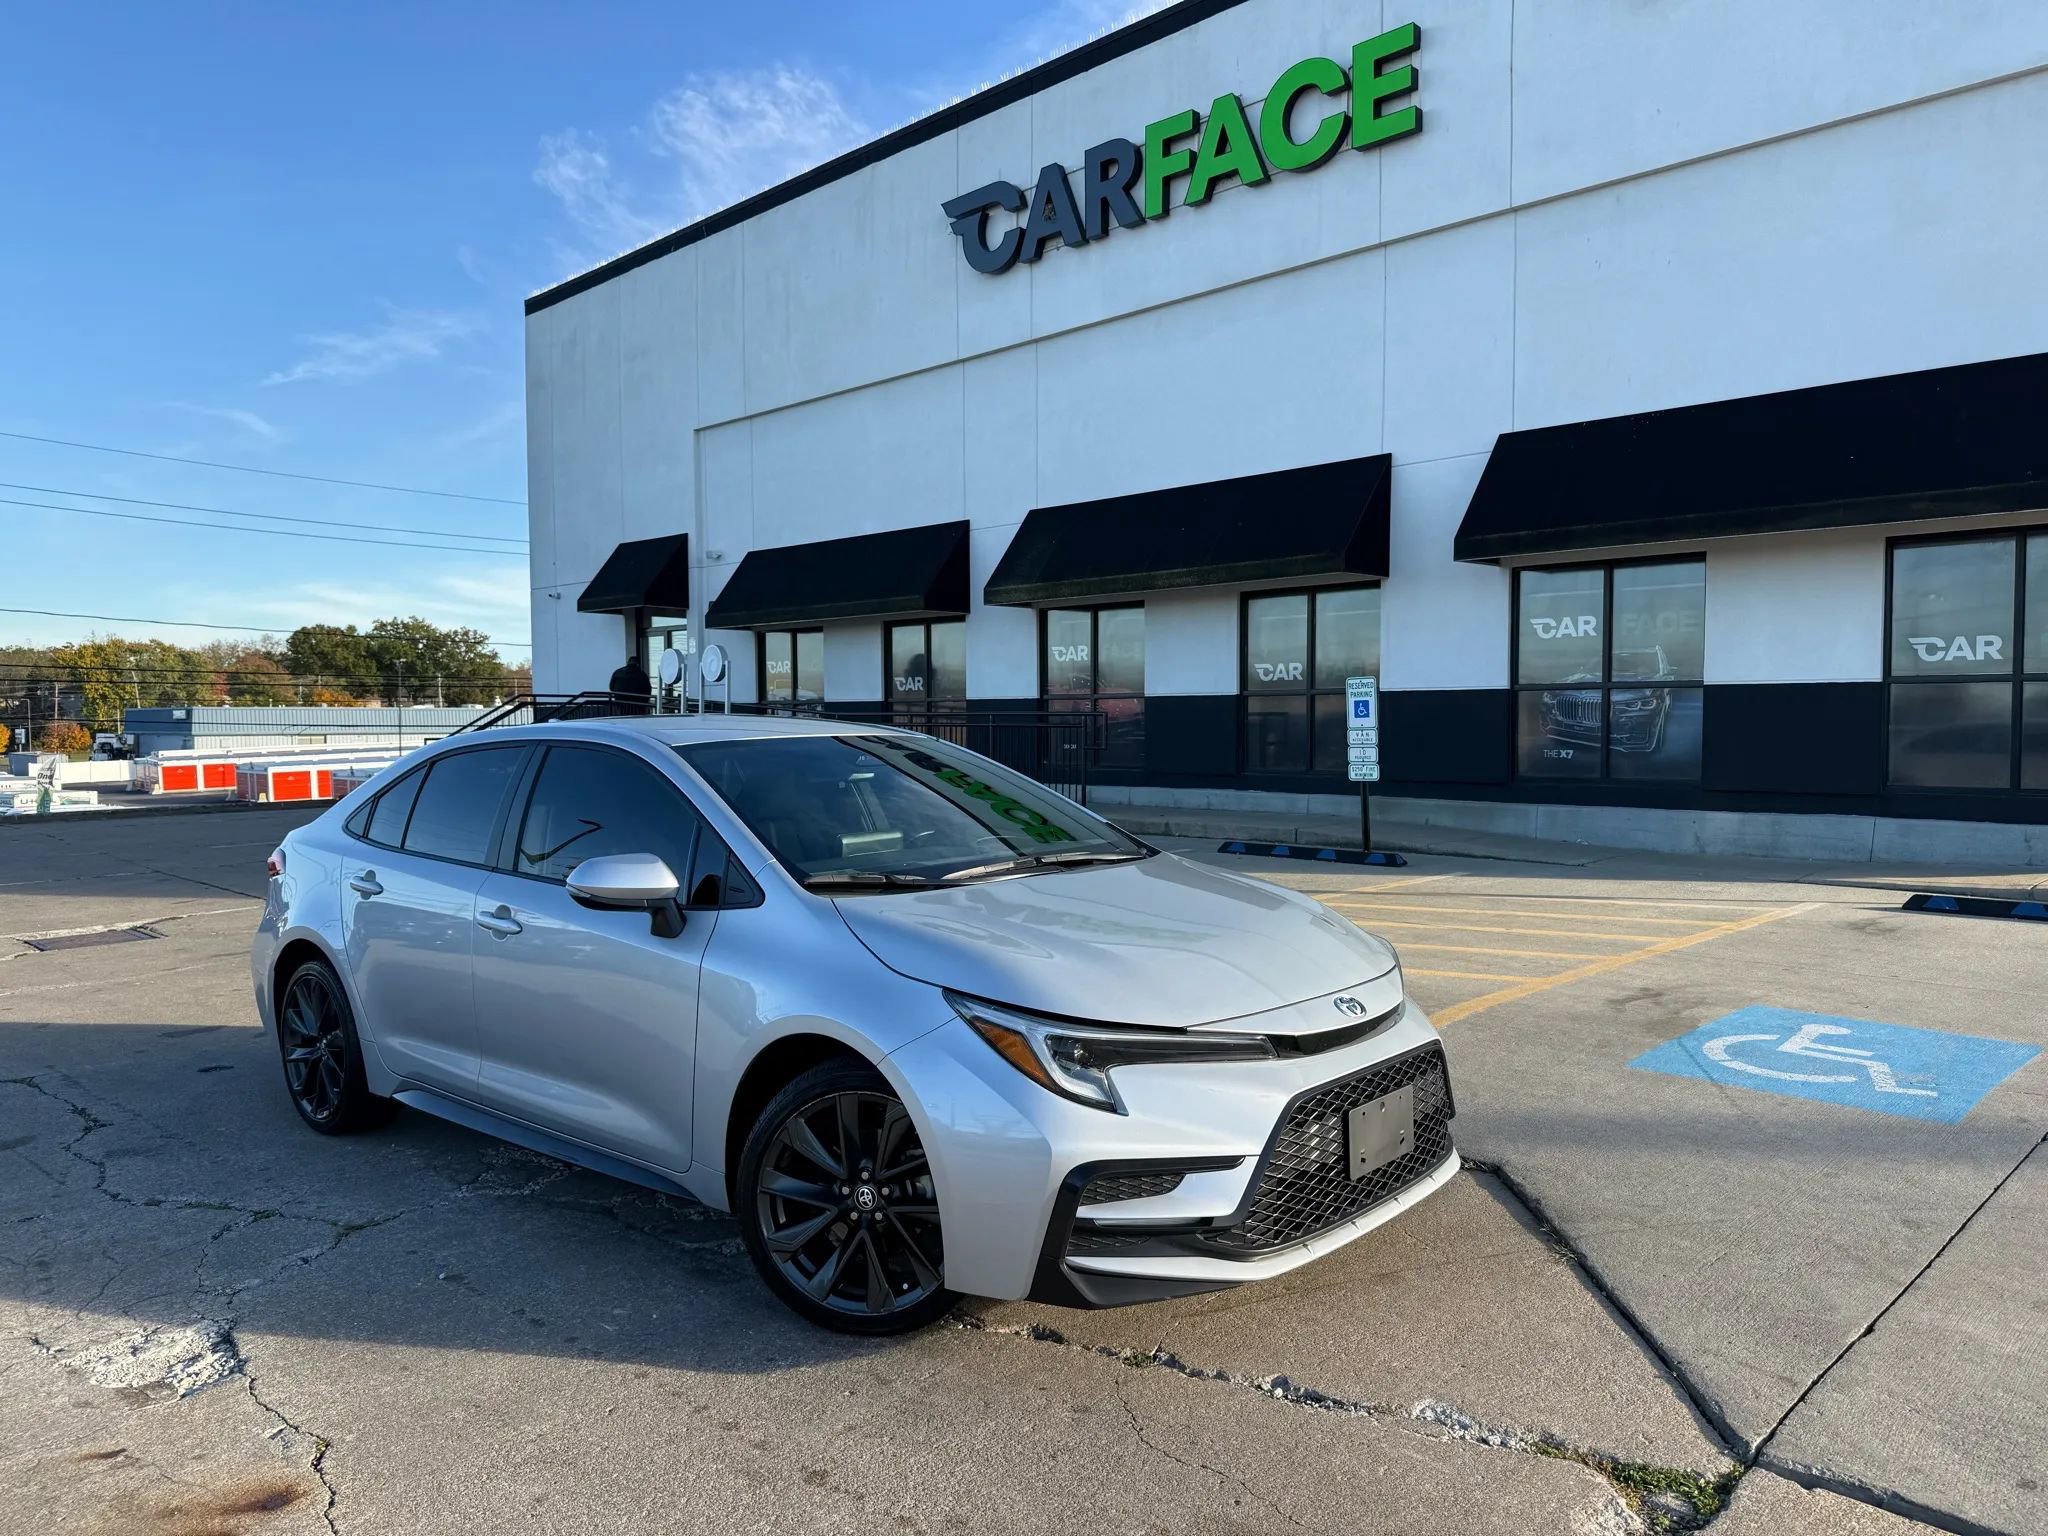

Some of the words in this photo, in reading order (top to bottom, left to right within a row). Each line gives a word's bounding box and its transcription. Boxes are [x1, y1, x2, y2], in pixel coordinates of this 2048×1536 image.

[941, 21, 1422, 274] CARFACE
[1530, 615, 1597, 639] CAR
[1051, 645, 1088, 662] CAR
[1907, 634, 2004, 662] CAR
[766, 660, 791, 674] CAR
[1253, 662, 1304, 682] CAR
[894, 676, 924, 692] CAR
[1348, 681, 1374, 690] RESERVED
[1350, 690, 1373, 699] PARKING
[1543, 749, 1559, 758] THE
[1559, 749, 1574, 759] X7
